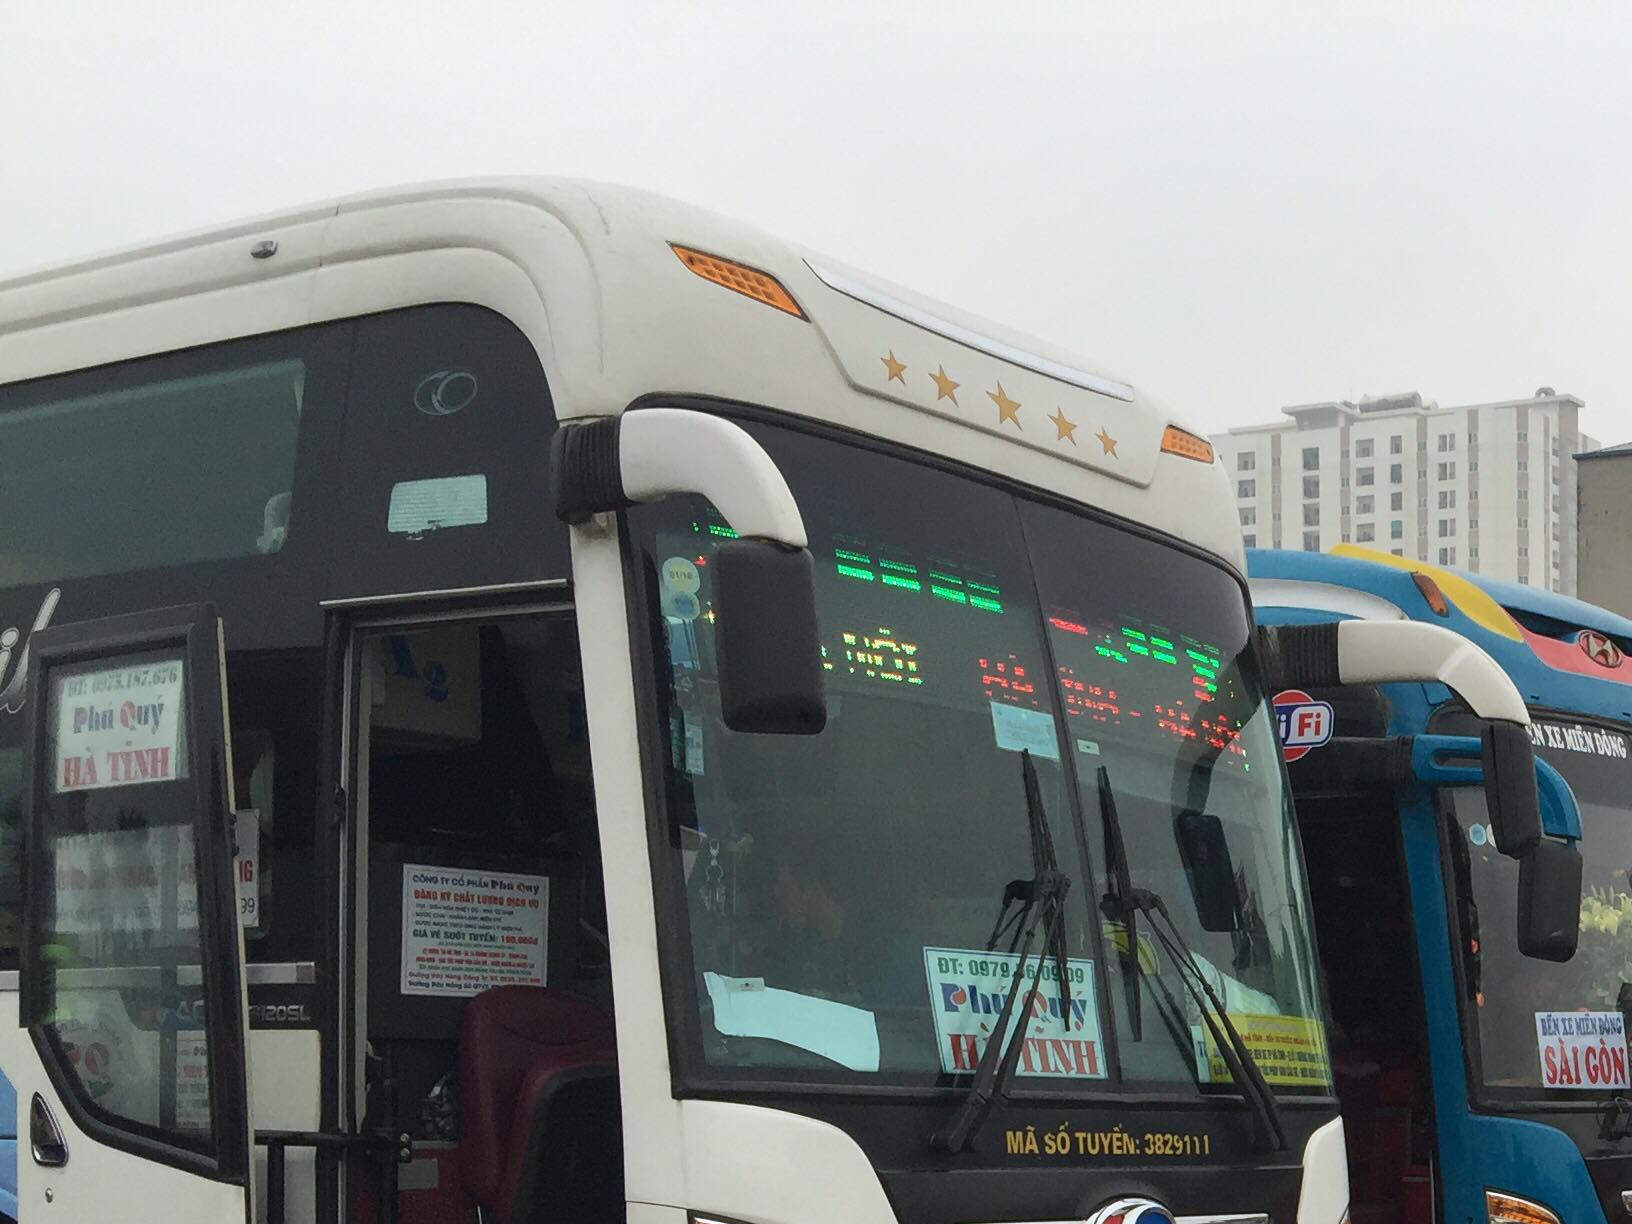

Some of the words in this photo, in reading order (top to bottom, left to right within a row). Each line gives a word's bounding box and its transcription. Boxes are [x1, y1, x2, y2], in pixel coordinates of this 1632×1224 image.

[1543, 724, 1566, 749] XE
[937, 956, 965, 976] ĐT:
[1562, 1015, 1576, 1036] XE
[1543, 1036, 1583, 1086] SÀI
[1584, 1038, 1627, 1085] GÒN
[1006, 1126, 1040, 1155] MÃ
[1044, 1121, 1071, 1154] SỐ
[1144, 1134, 1210, 1155] 3829111
